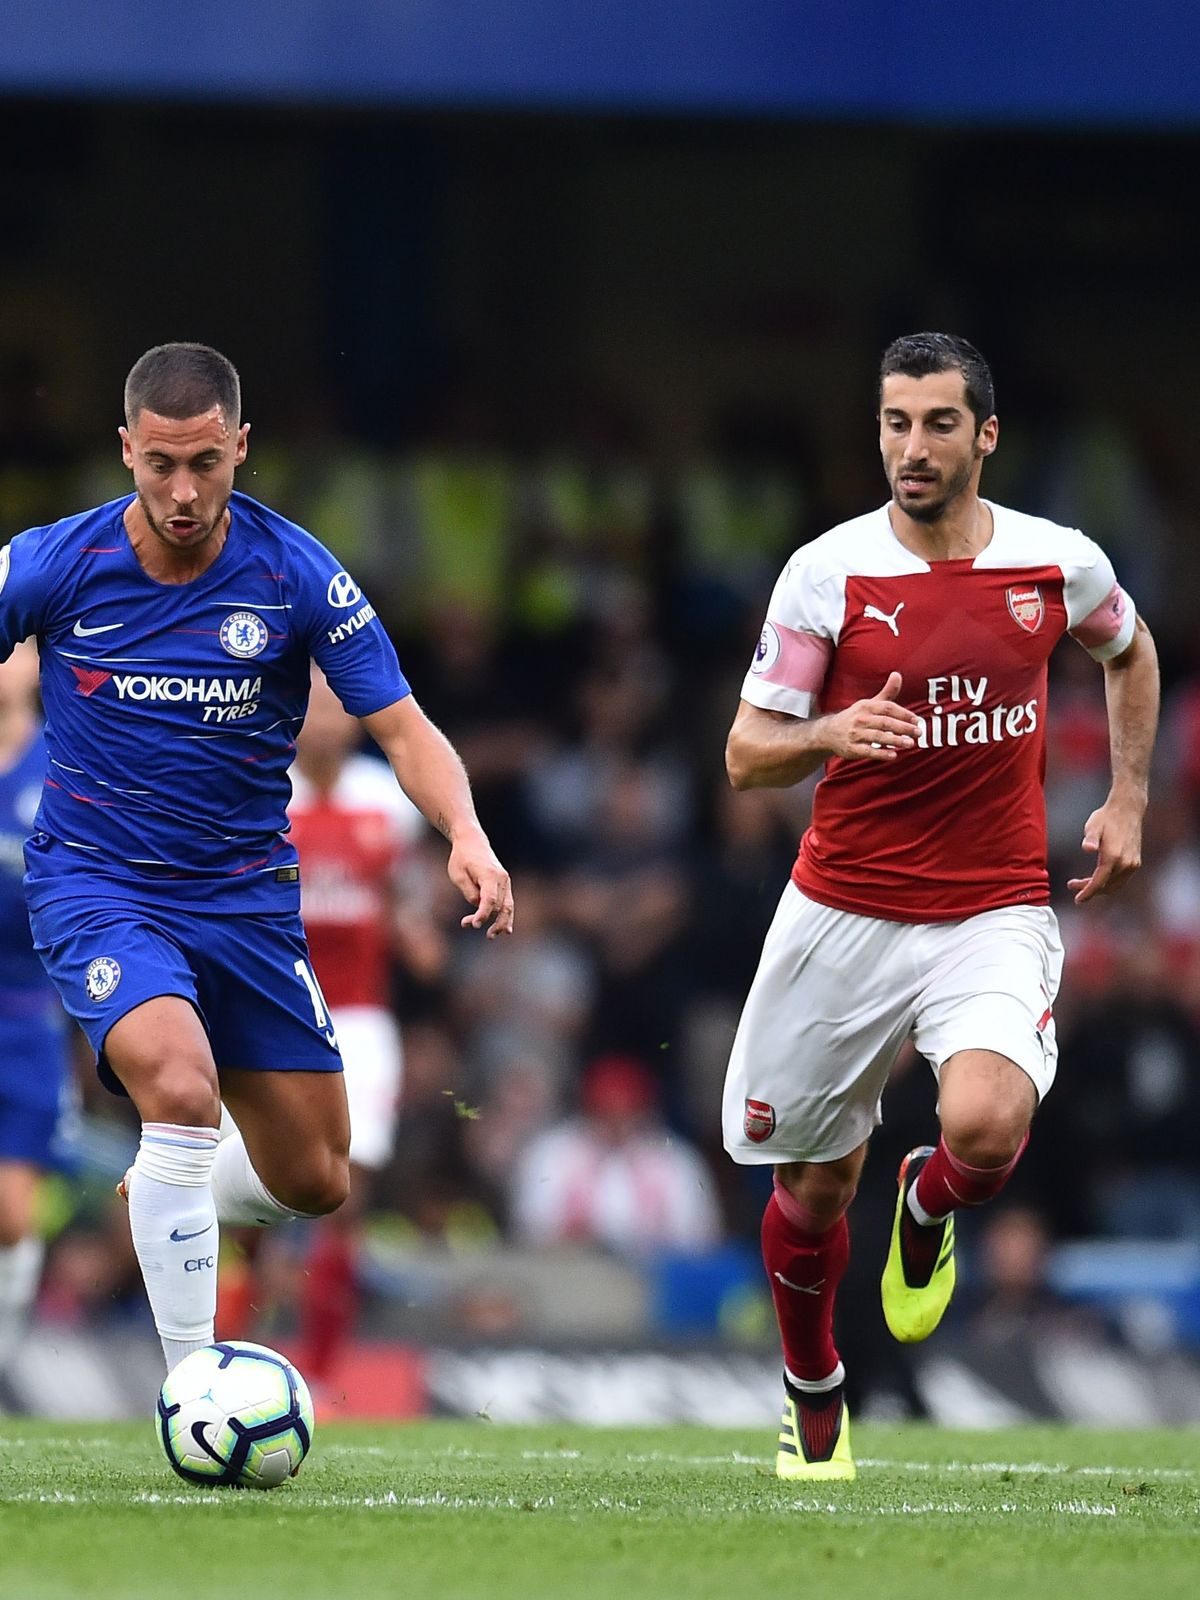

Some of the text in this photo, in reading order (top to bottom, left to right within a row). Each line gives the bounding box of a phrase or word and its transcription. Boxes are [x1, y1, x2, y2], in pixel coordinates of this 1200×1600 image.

[112, 675, 262, 703] YOKOHAMA
[927, 674, 988, 706] Fly
[202, 700, 261, 723] TYRES
[871, 698, 1039, 749] irates
[184, 1255, 214, 1272] CFC
